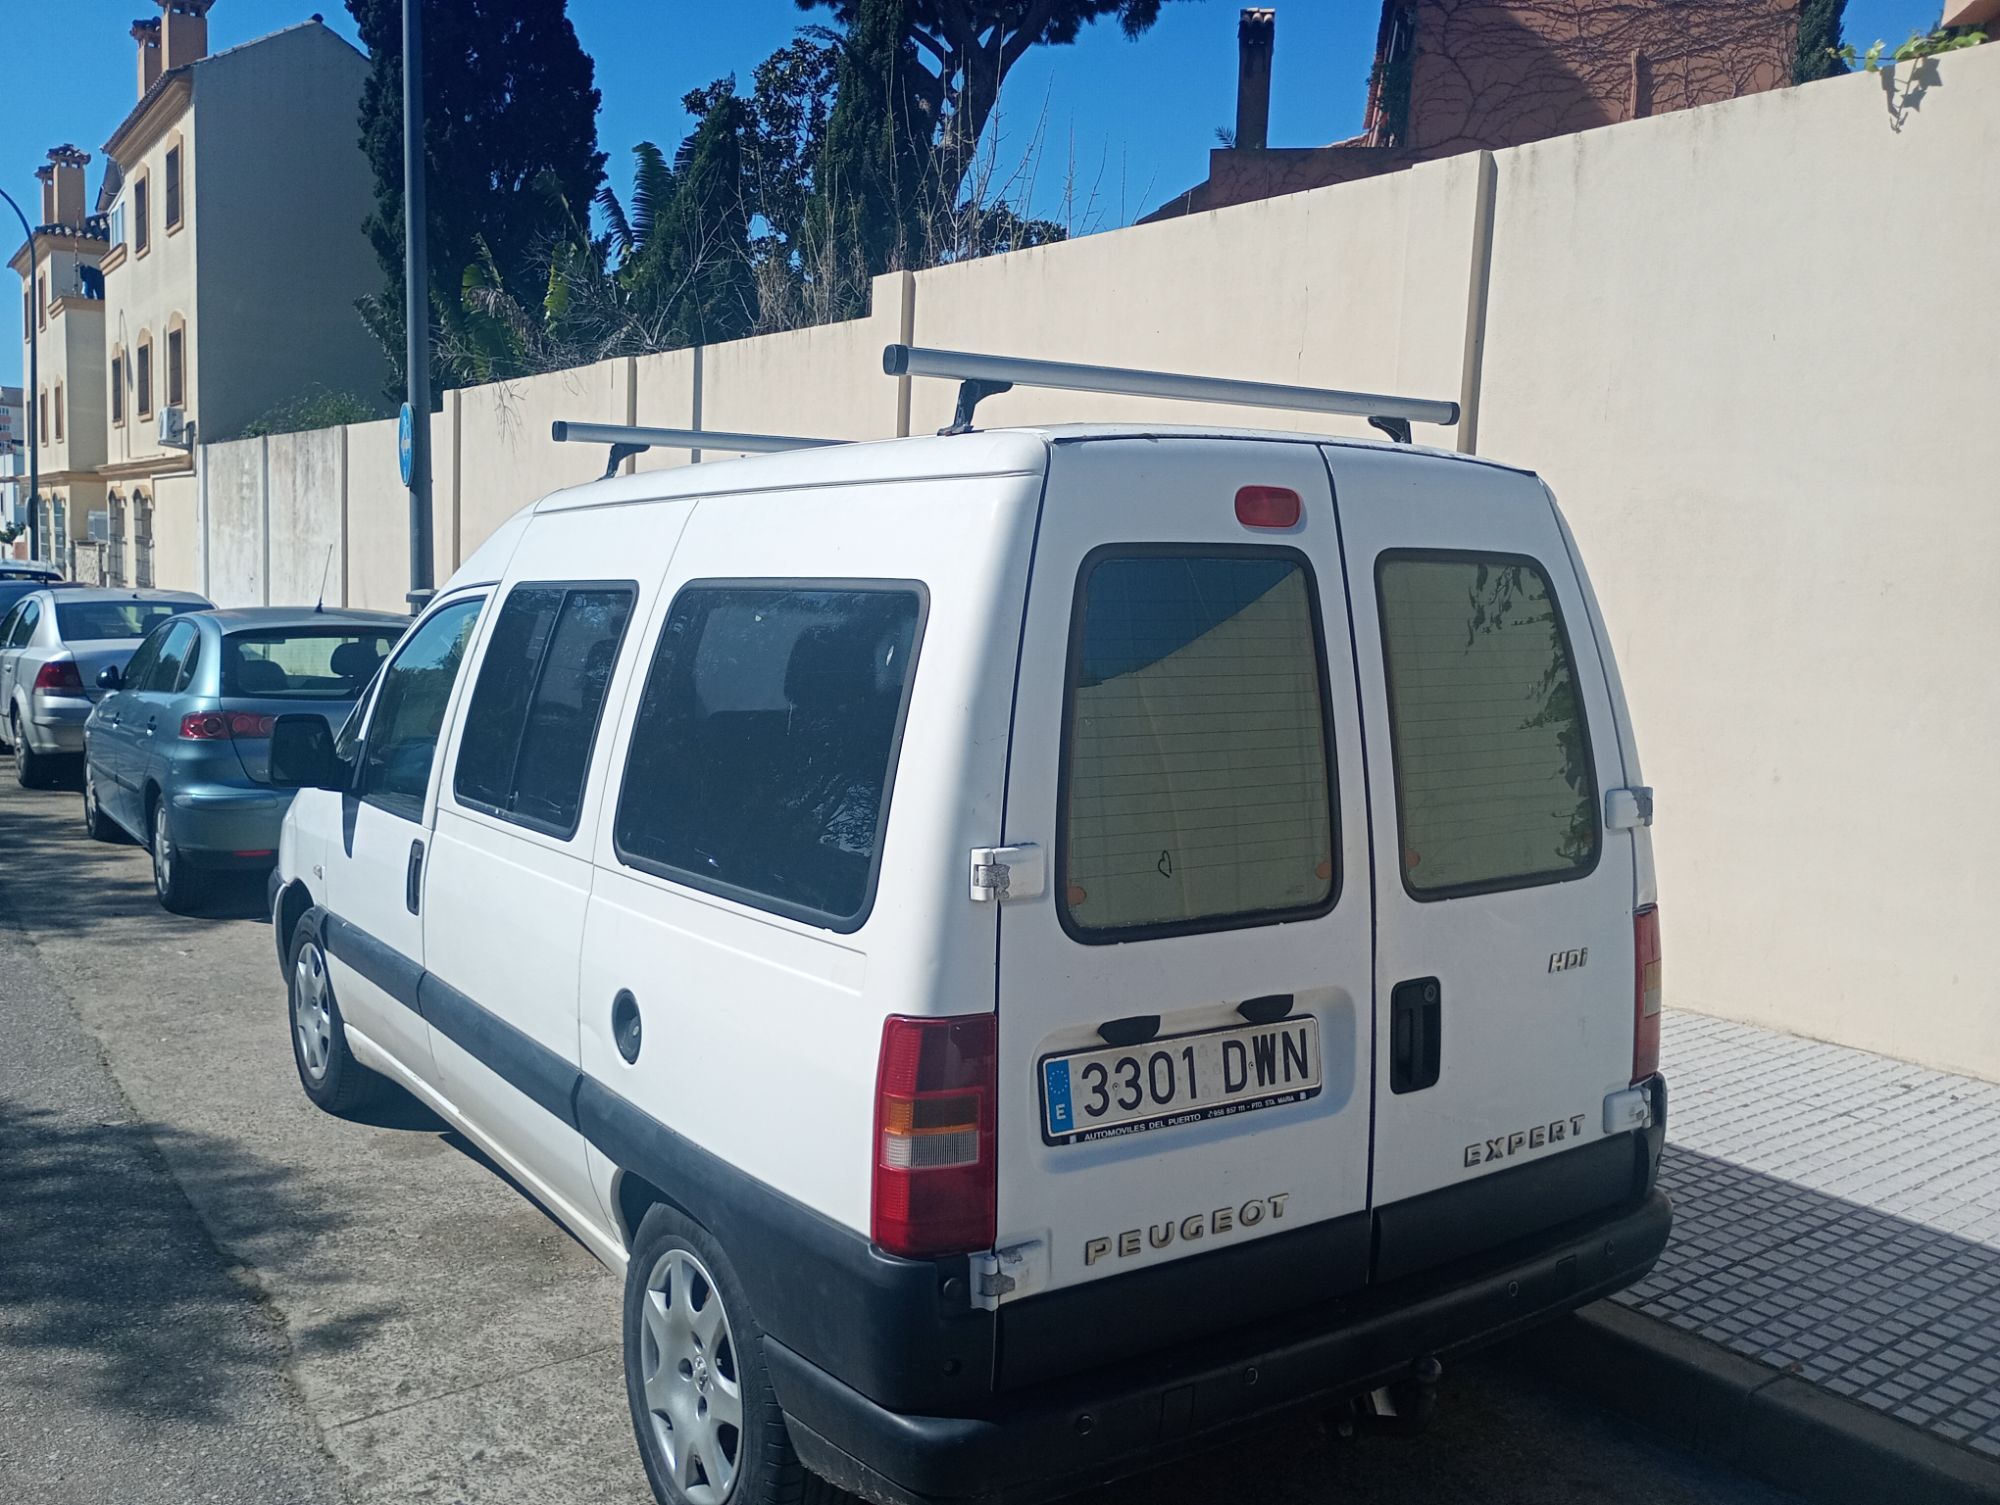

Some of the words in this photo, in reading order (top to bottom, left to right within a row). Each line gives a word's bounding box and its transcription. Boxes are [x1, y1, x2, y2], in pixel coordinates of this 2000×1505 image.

[1081, 1046, 1197, 1117] 3301
[1222, 1028, 1309, 1094] DWN
[1056, 1104, 1066, 1120] E
[1084, 1123, 1146, 1141] AUTOMOVILES
[1149, 1120, 1166, 1130] DEL
[1168, 1113, 1201, 1125] PUERTO
[1463, 1114, 1586, 1168] EXPERT
[1084, 1192, 1289, 1265] PEUGEOT
